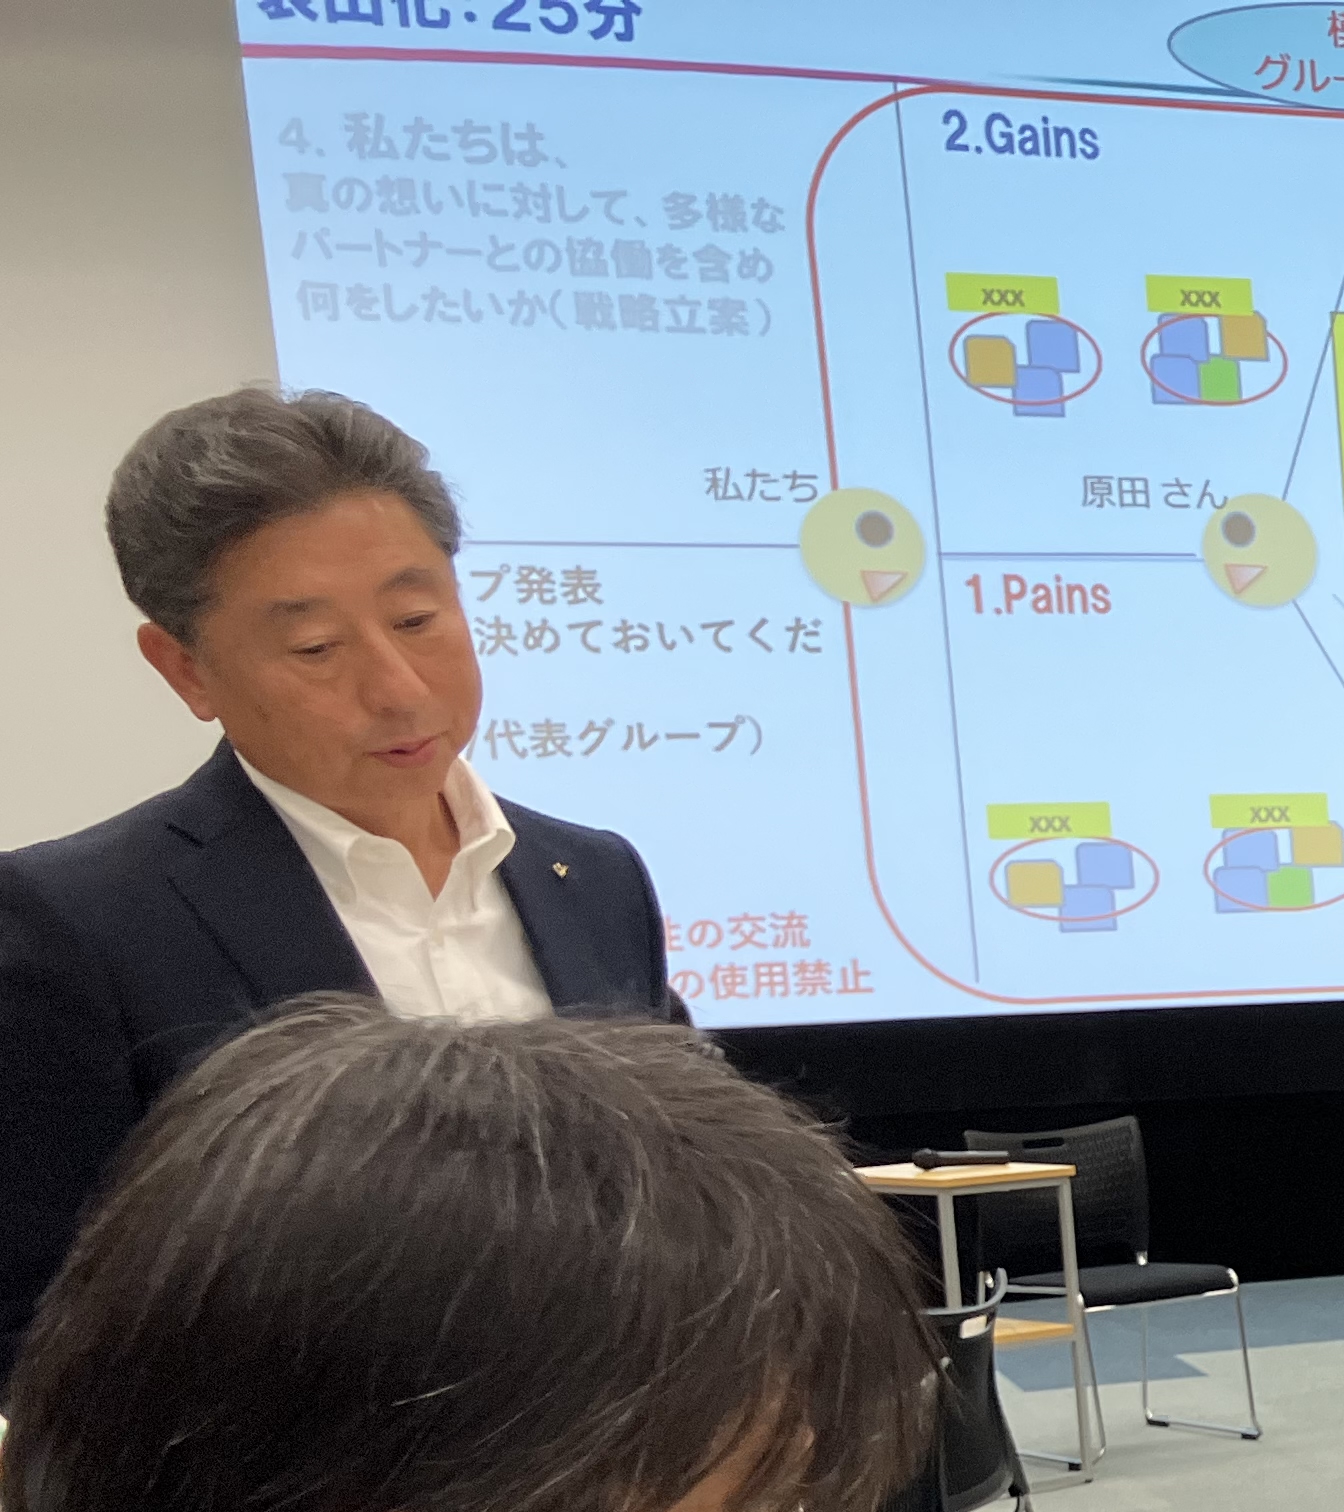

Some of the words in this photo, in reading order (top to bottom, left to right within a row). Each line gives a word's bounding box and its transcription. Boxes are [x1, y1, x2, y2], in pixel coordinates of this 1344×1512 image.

[343, 112, 568, 170] 私たちは、
[941, 109, 1100, 160] 2.Gains
[283, 171, 787, 236] 真の想いに対して、多様な
[291, 230, 775, 285] パートナーとの協働を含め
[703, 465, 819, 504] 私たち
[1081, 475, 1151, 511] 原田
[1161, 477, 1229, 513] さん
[965, 573, 1113, 617] 1.Pains
[473, 614, 823, 657] 決めておいてくだ
[669, 962, 876, 1000] の使用禁止
